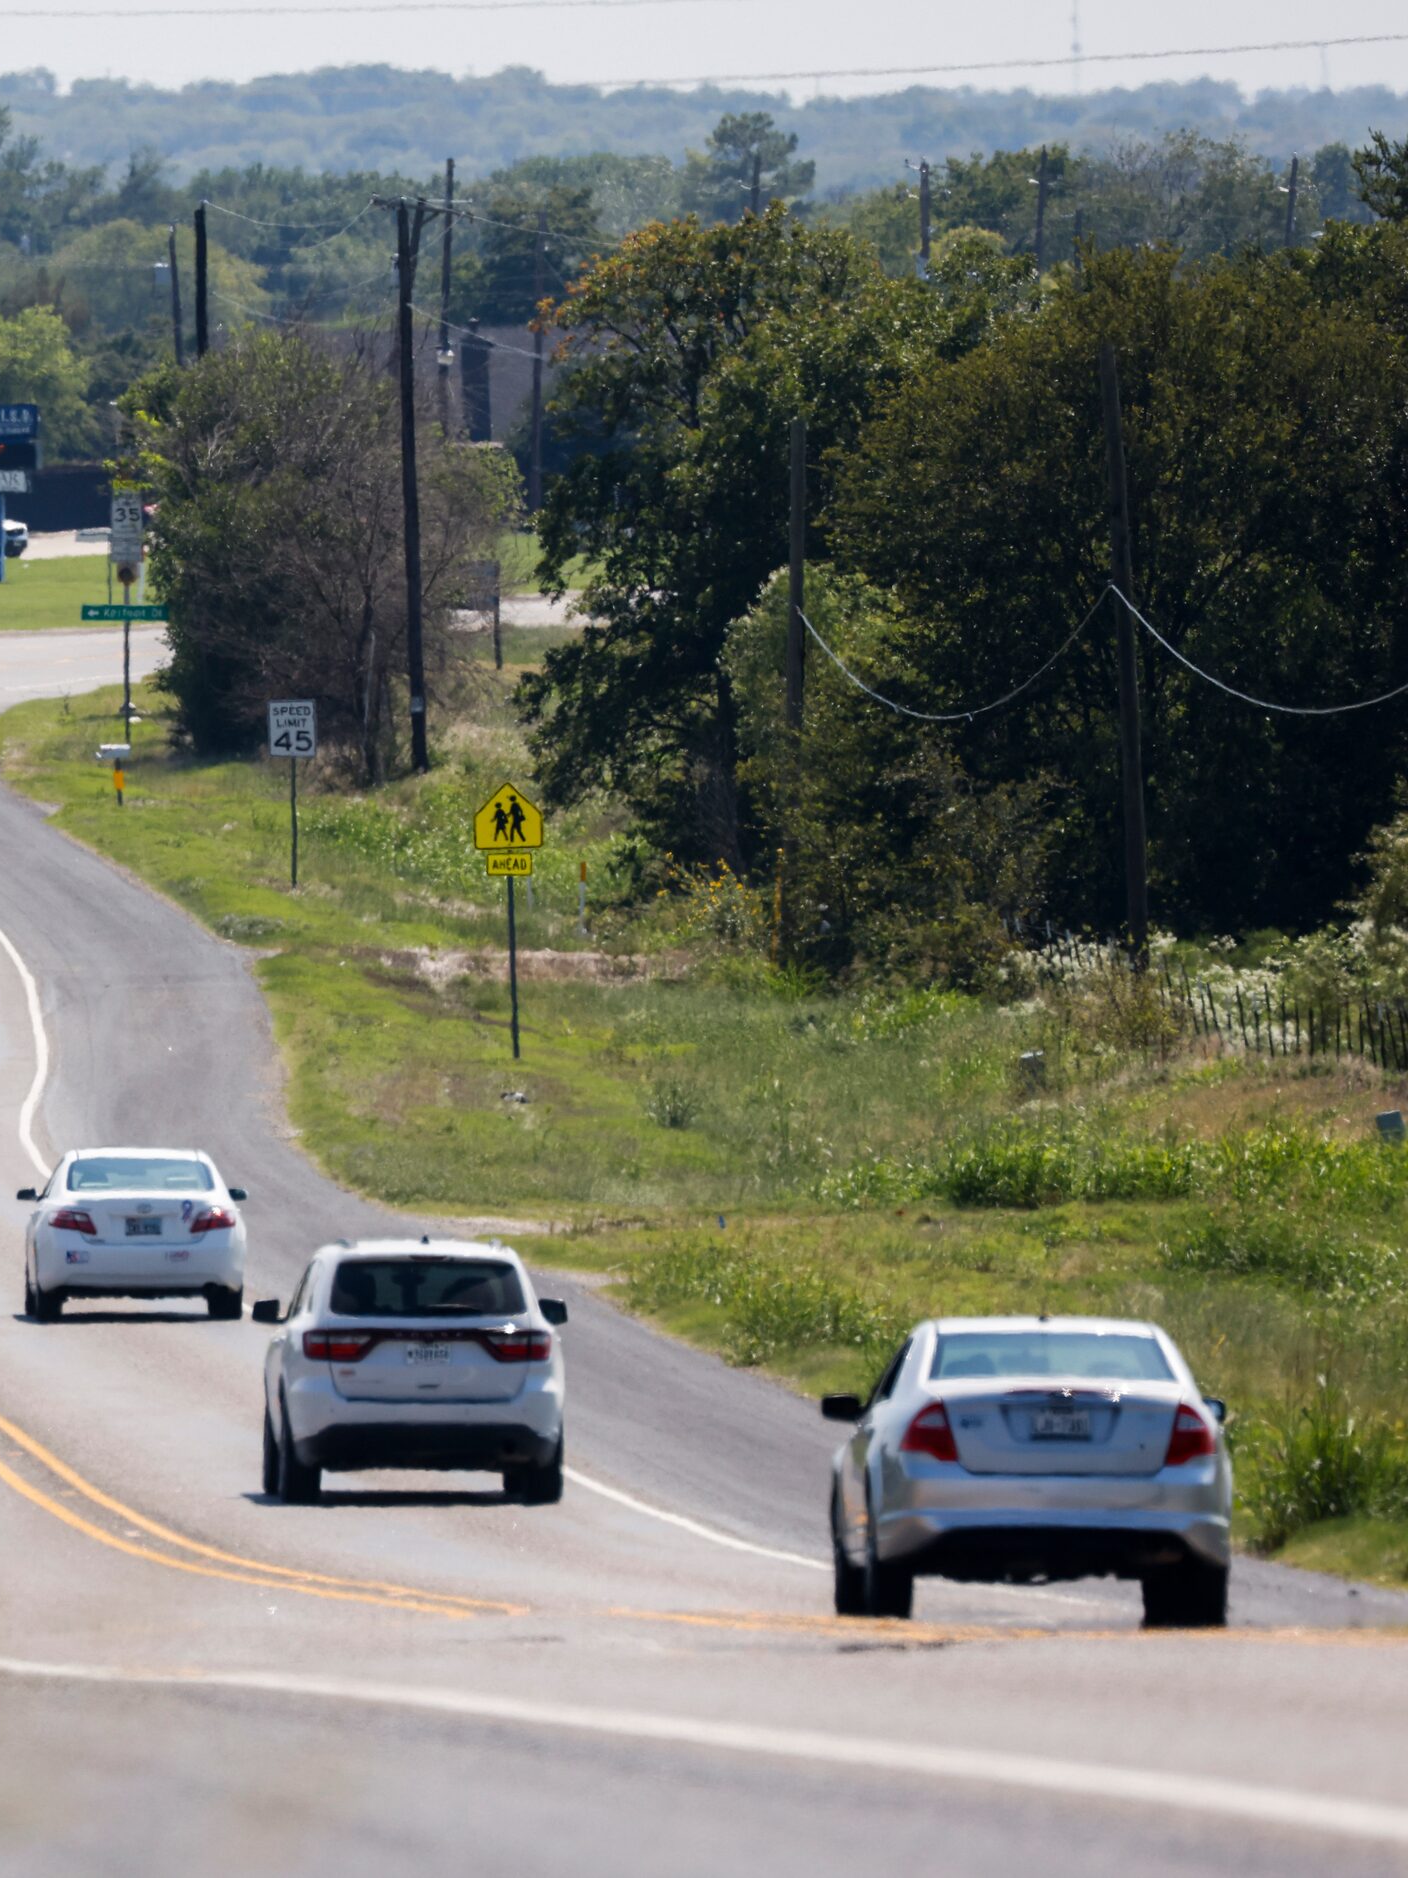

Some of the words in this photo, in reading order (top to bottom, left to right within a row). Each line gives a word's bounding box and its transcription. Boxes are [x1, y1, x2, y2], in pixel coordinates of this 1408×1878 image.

[114, 507, 141, 522] 35
[273, 706, 311, 716] SPEED
[276, 718, 307, 728] LIMIT
[274, 730, 313, 752] 45
[492, 858, 527, 871] AHEAD
